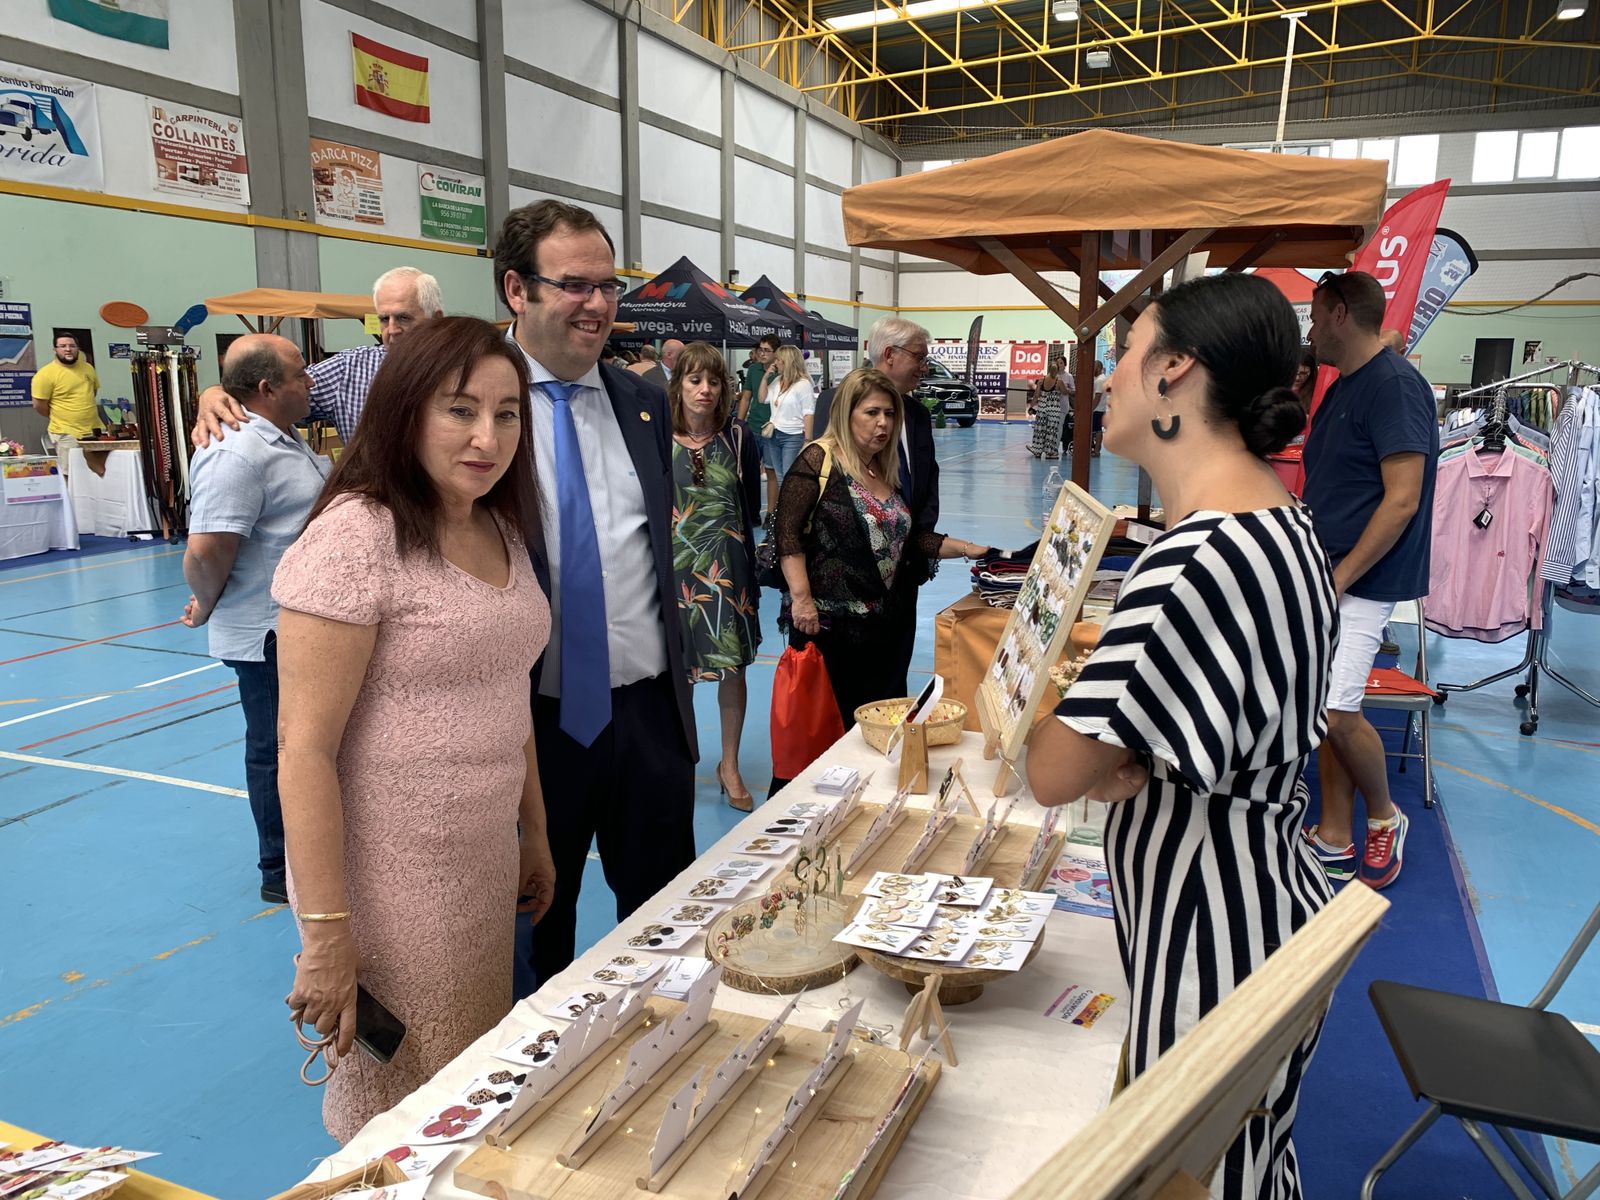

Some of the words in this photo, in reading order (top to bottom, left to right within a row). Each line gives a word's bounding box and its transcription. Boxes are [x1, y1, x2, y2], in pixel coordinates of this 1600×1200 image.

[0, 75, 28, 87] centro
[29, 80, 74, 98] Formación
[153, 122, 236, 152] COLLANTES
[311, 147, 349, 164] BARCA
[350, 151, 379, 176] PIZZA
[436, 180, 482, 198] COVIRAN
[682, 319, 713, 333] vive
[729, 320, 751, 337] Habla,
[778, 325, 793, 338] vive
